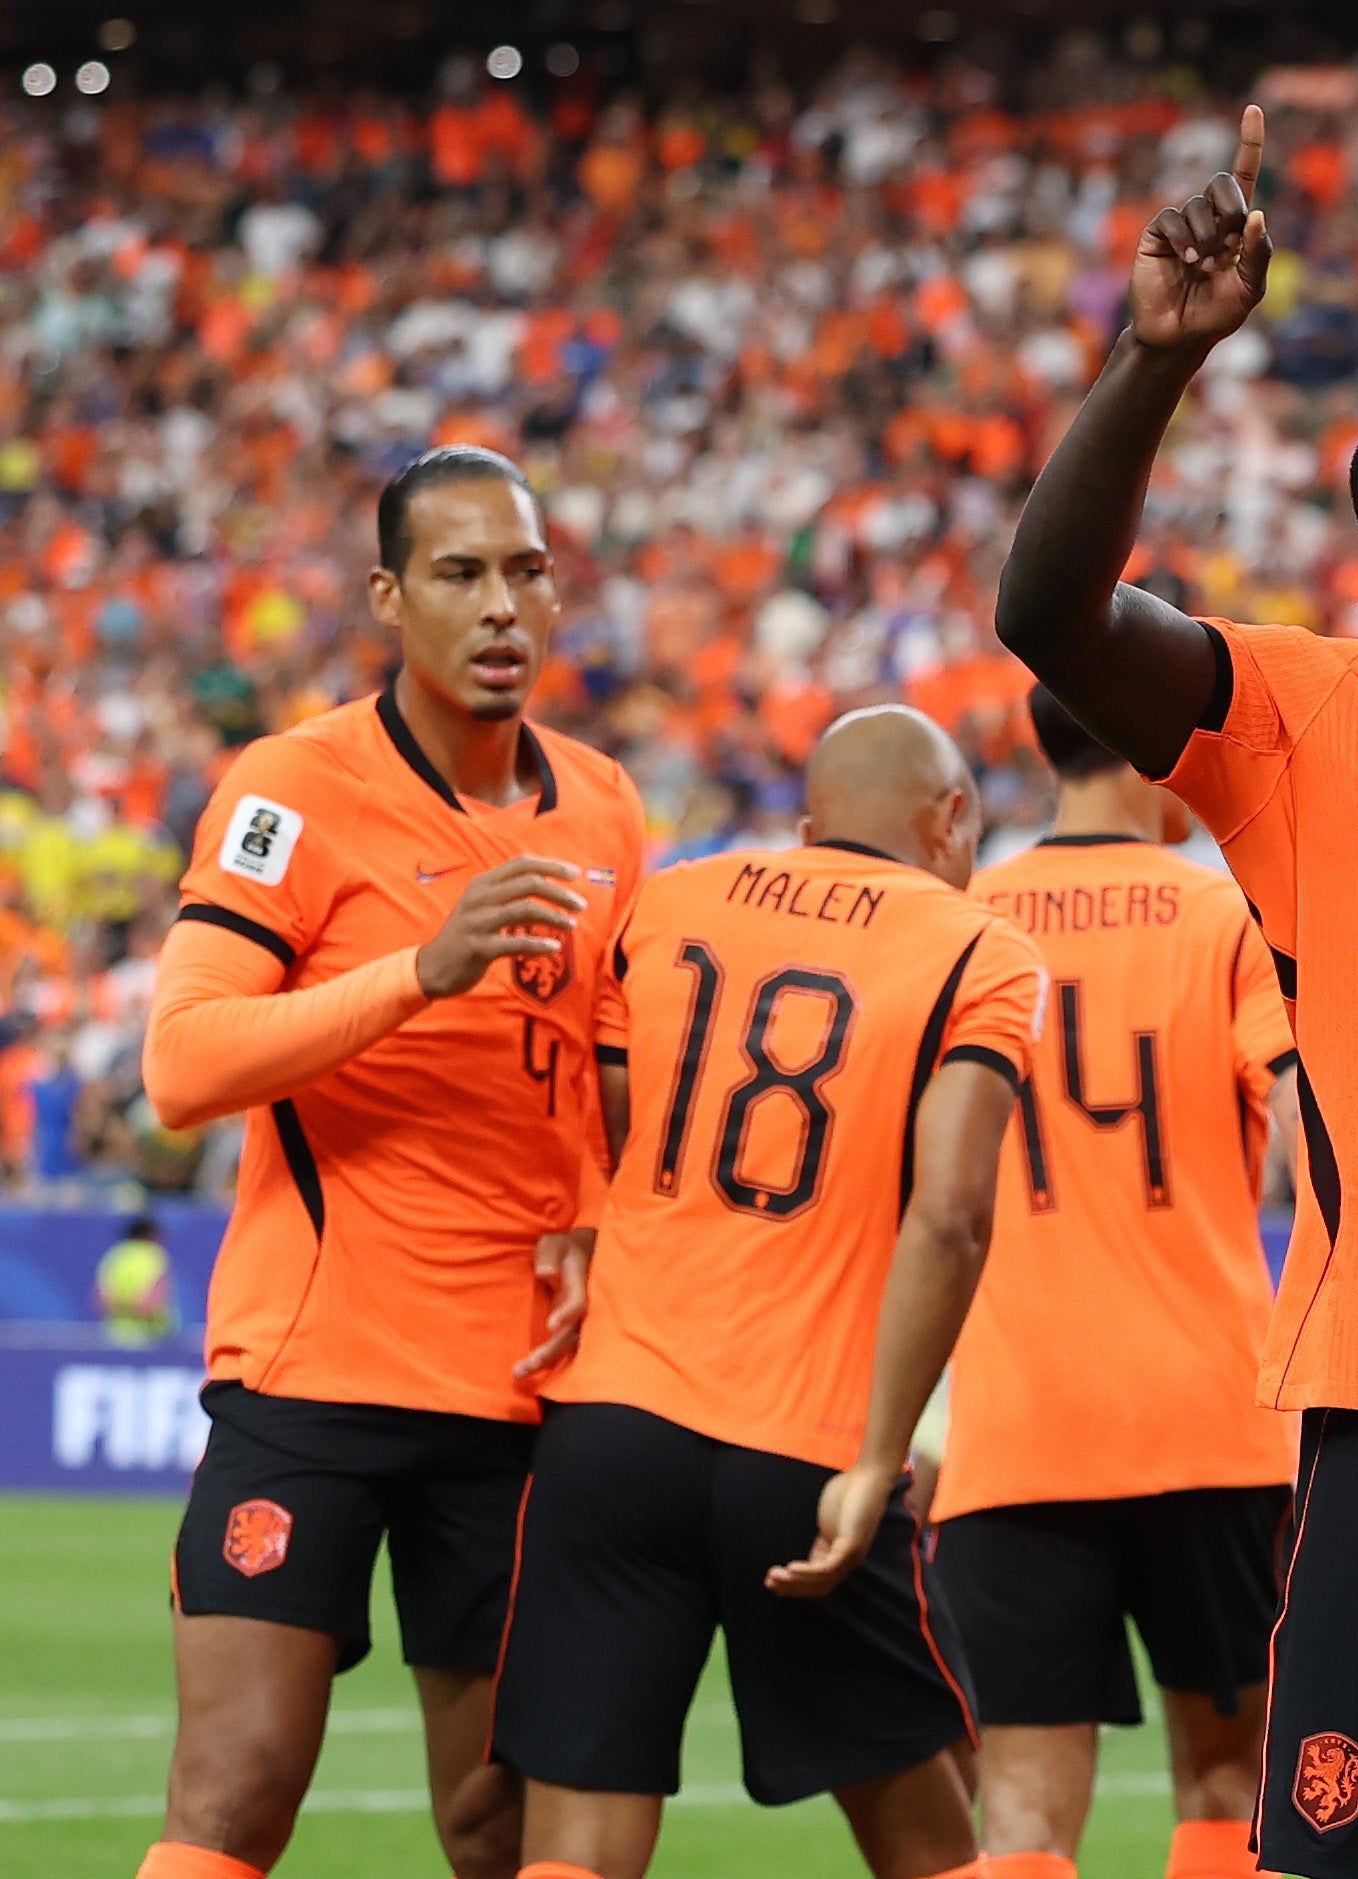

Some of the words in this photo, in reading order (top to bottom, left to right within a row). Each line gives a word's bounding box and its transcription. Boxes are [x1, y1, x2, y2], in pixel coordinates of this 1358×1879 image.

[726, 863, 887, 929] MALEN
[523, 1014, 560, 1118] 4
[653, 938, 863, 1222] 18
